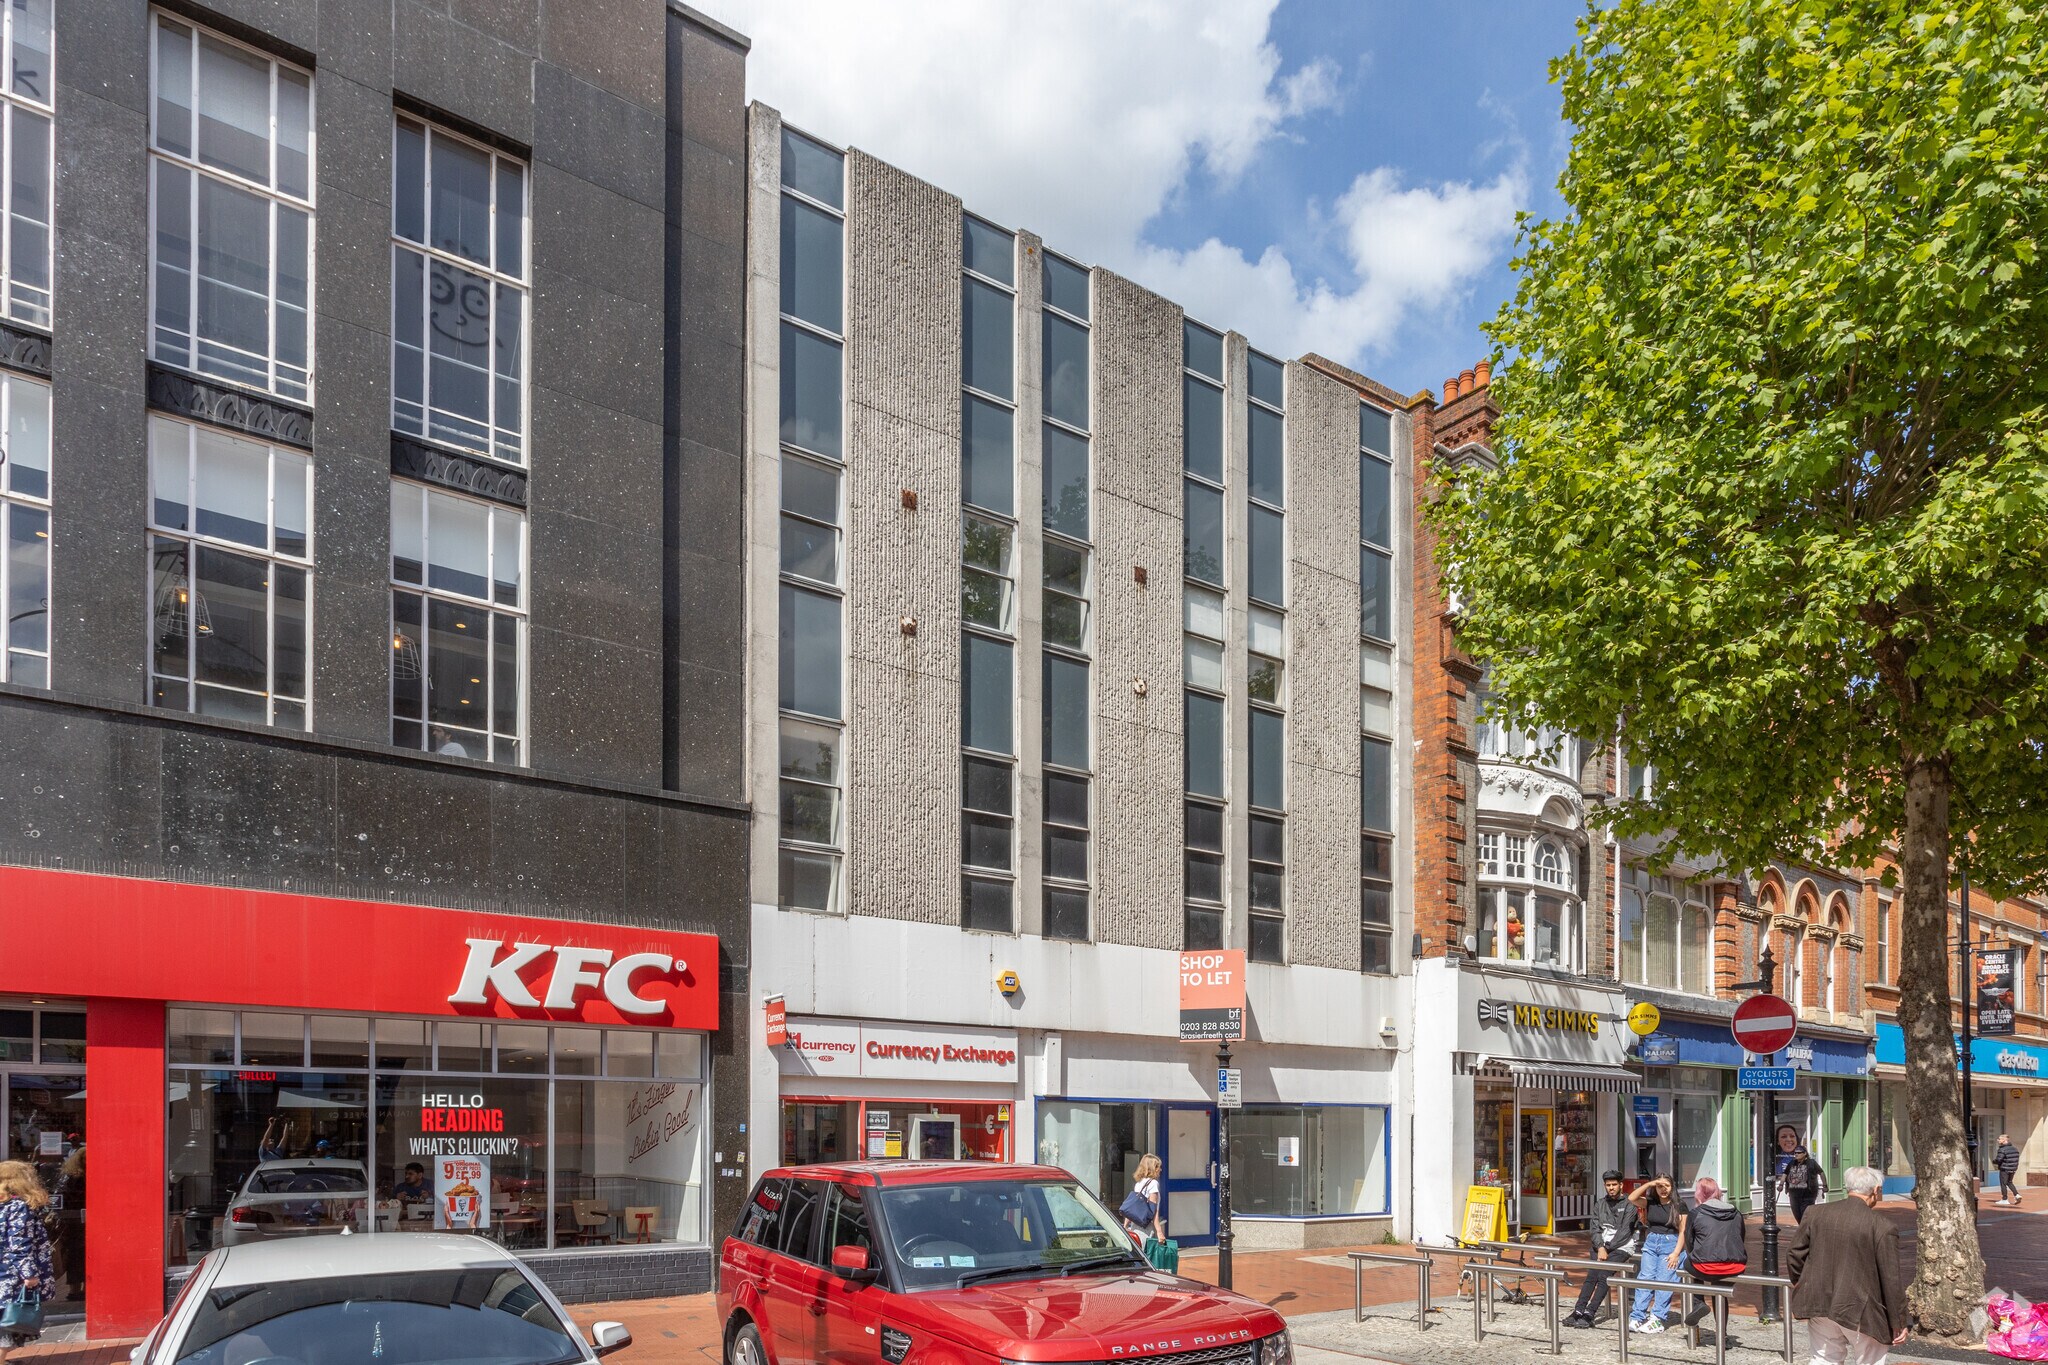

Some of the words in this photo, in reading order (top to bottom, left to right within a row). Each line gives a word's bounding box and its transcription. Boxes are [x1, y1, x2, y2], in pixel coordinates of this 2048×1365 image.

[1181, 955, 1224, 970] SHOP
[1005, 977, 1015, 985] ADT
[1181, 972, 1203, 986] TO
[1208, 971, 1232, 985] LET
[768, 1013, 784, 1022] Currency
[1229, 1008, 1240, 1019] bf
[1515, 1004, 1541, 1027] MR
[1546, 1009, 1599, 1034] SIMMS
[768, 1023, 785, 1033] Exchange
[1181, 1022, 1200, 1031] 0203
[1202, 1022, 1217, 1030] 828
[1220, 1021, 1240, 1030] 8530
[1181, 1030, 1240, 1039] brasierfreethcom
[866, 1041, 940, 1062] Currency
[943, 1044, 1016, 1065] Exchange
[1787, 1047, 1813, 1060] HALIFAX
[1745, 1070, 1788, 1078] CYCLISTS
[1742, 1078, 1791, 1086] DISMOUNT
[422, 1094, 484, 1108] HELLO
[421, 1108, 504, 1132] READING
[664, 1089, 693, 1142] Good
[409, 1137, 456, 1156] WHAT'S
[458, 1137, 519, 1156] CLUCKIN'?
[444, 1163, 454, 1180] 9
[456, 1171, 482, 1185] £5.99
[1112, 1339, 1182, 1355] RANGE
[1194, 1329, 1250, 1345] ROVER
